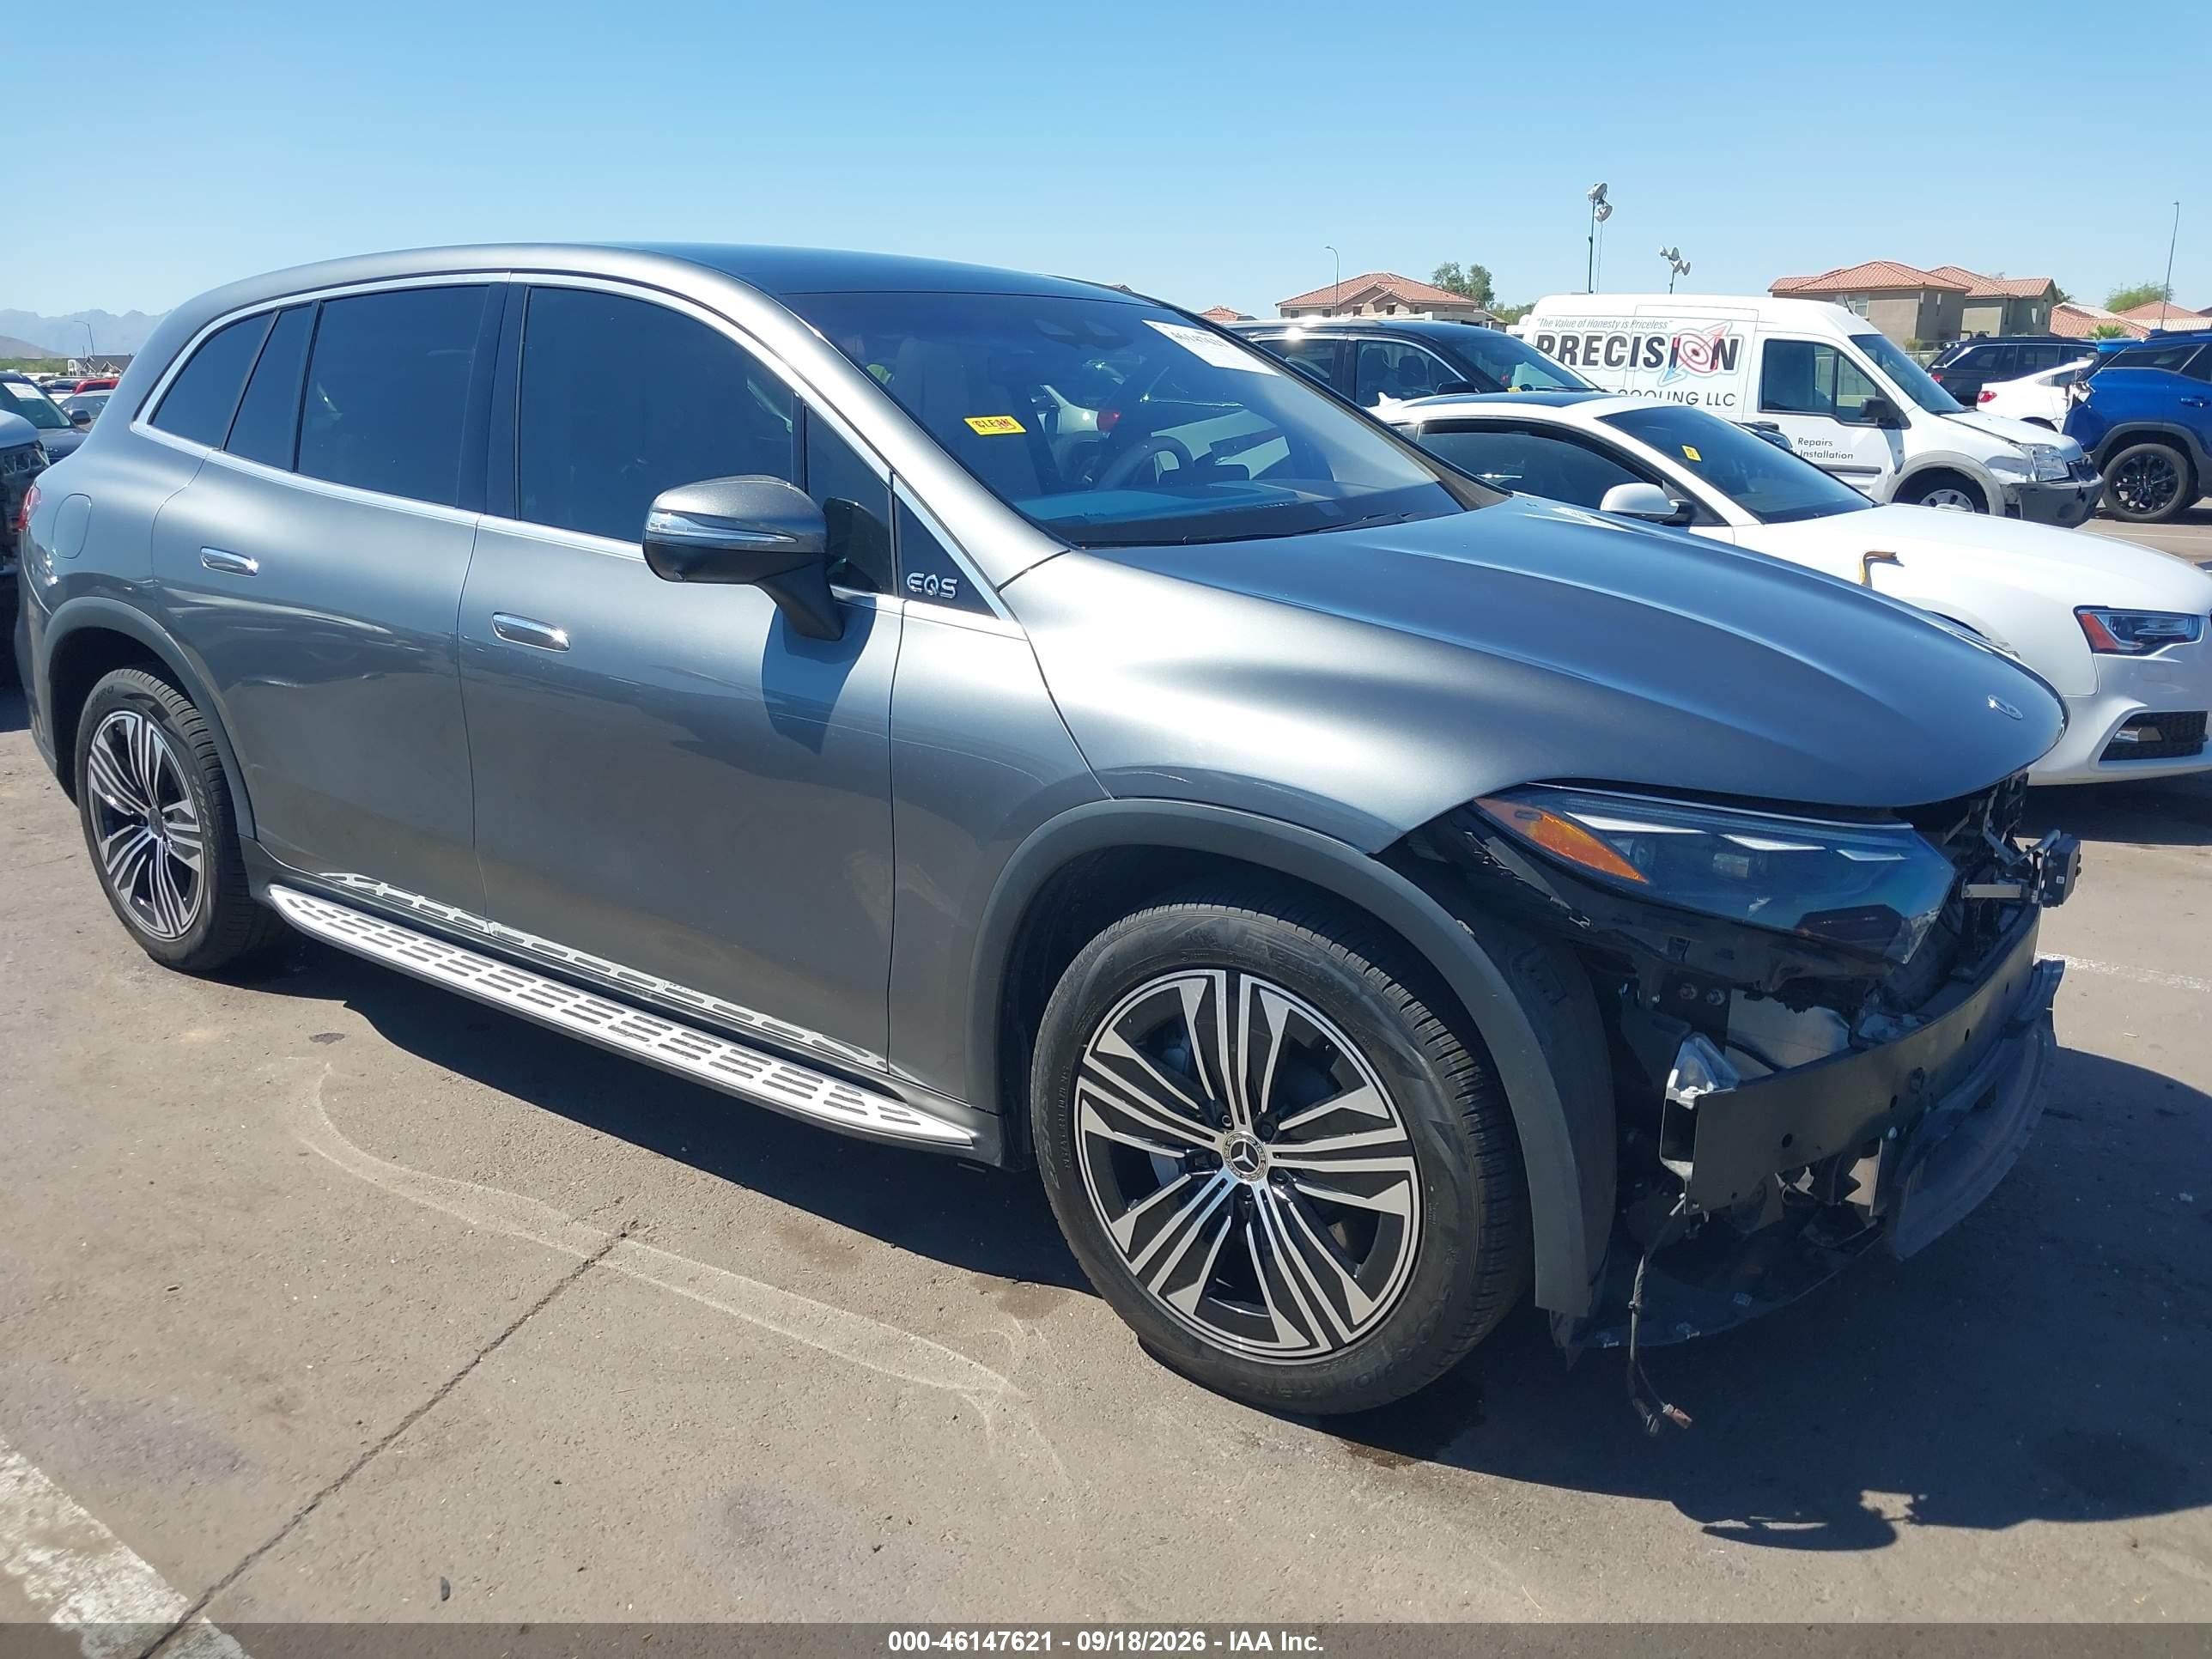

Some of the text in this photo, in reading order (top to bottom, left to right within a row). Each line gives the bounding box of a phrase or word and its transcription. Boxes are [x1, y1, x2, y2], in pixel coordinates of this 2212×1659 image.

[1554, 319, 1577, 328] Value
[1577, 319, 1587, 328] of
[1586, 319, 1620, 330] Honesty
[1621, 319, 1630, 329] is
[1536, 334, 1739, 373] PRECISION
[1706, 392, 1736, 406] LLC
[1797, 437, 1833, 447] Repairs
[1800, 449, 1853, 459] Installation
[907, 572, 957, 599] EQS
